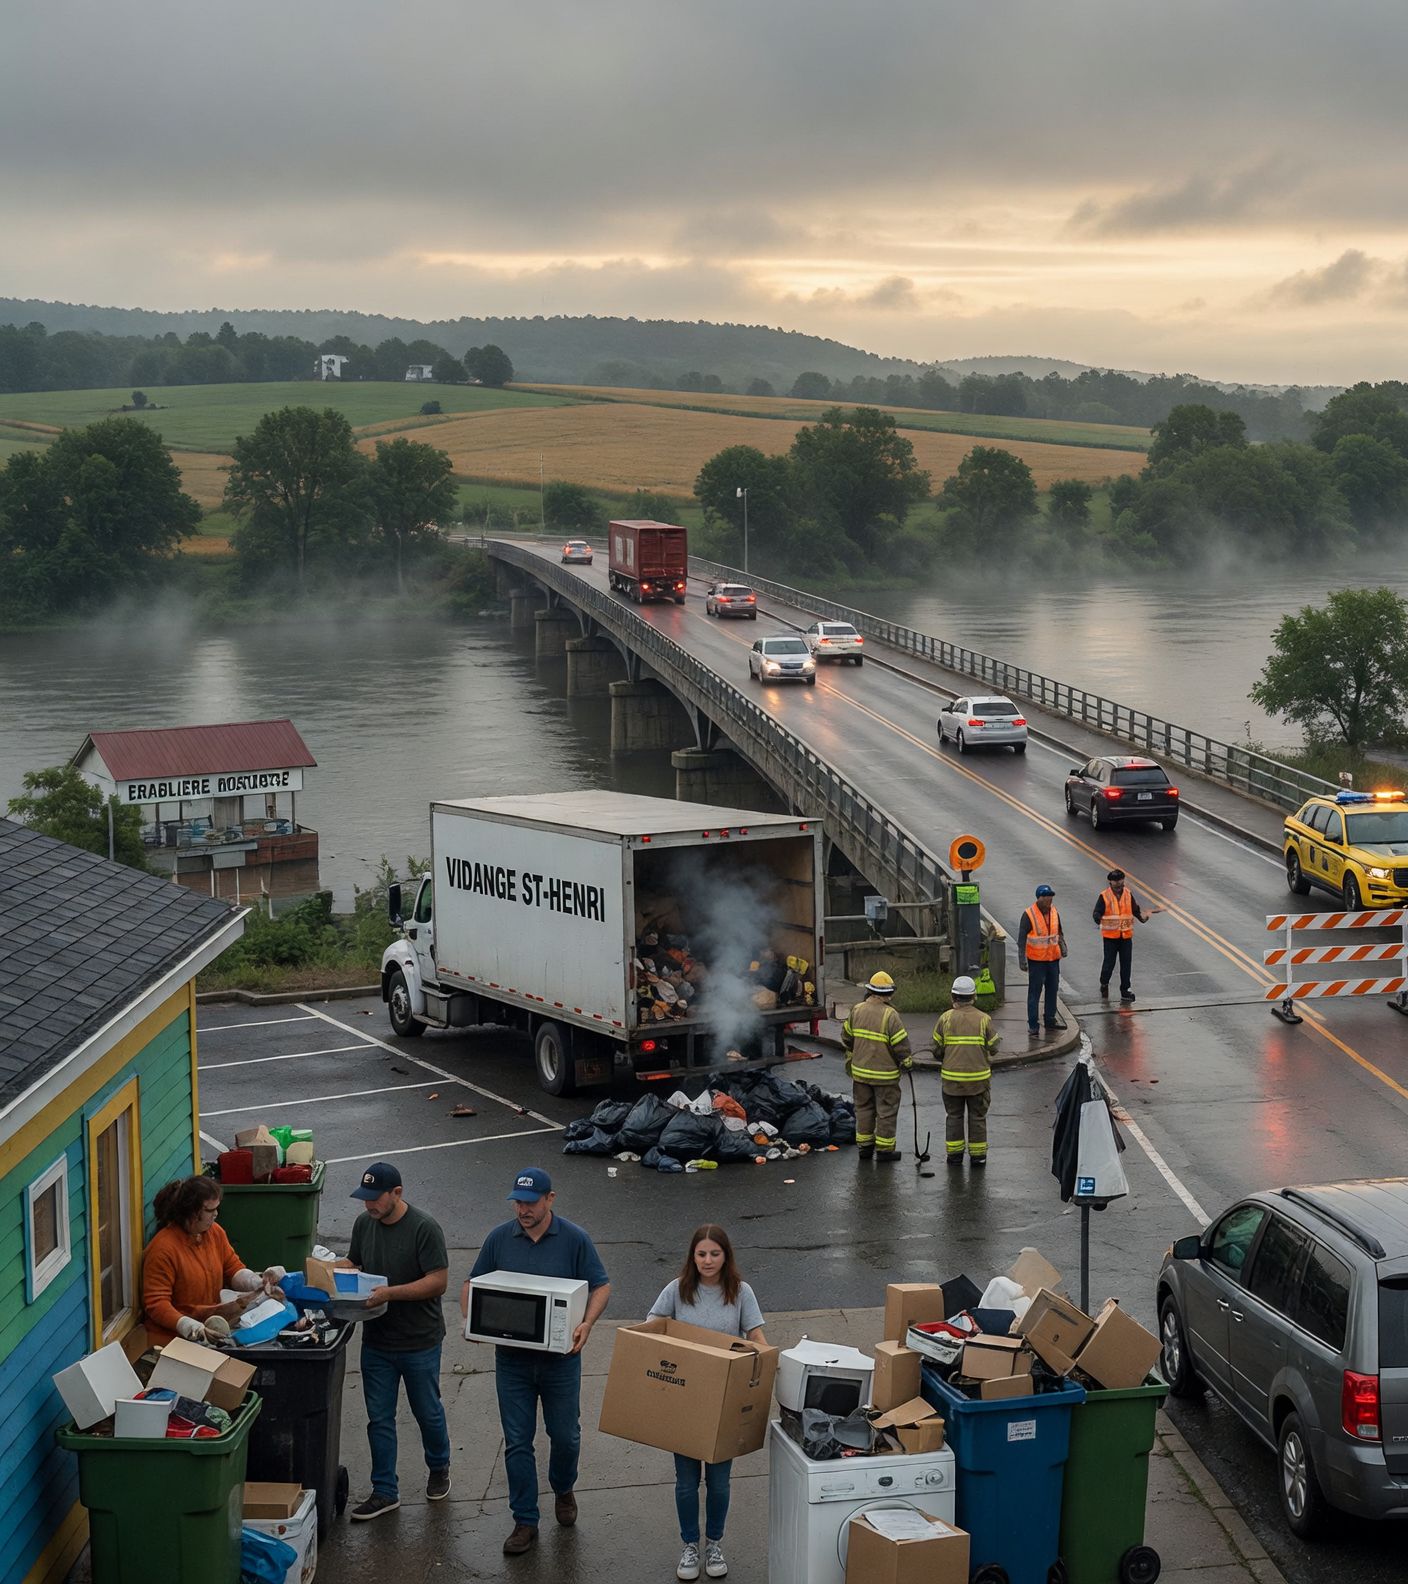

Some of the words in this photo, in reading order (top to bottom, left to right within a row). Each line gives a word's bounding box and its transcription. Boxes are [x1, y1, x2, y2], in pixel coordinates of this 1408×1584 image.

[129, 779, 210, 800] ERABLIERE
[446, 857, 517, 901] VIDANGE
[522, 873, 605, 922] ST-HENRI
